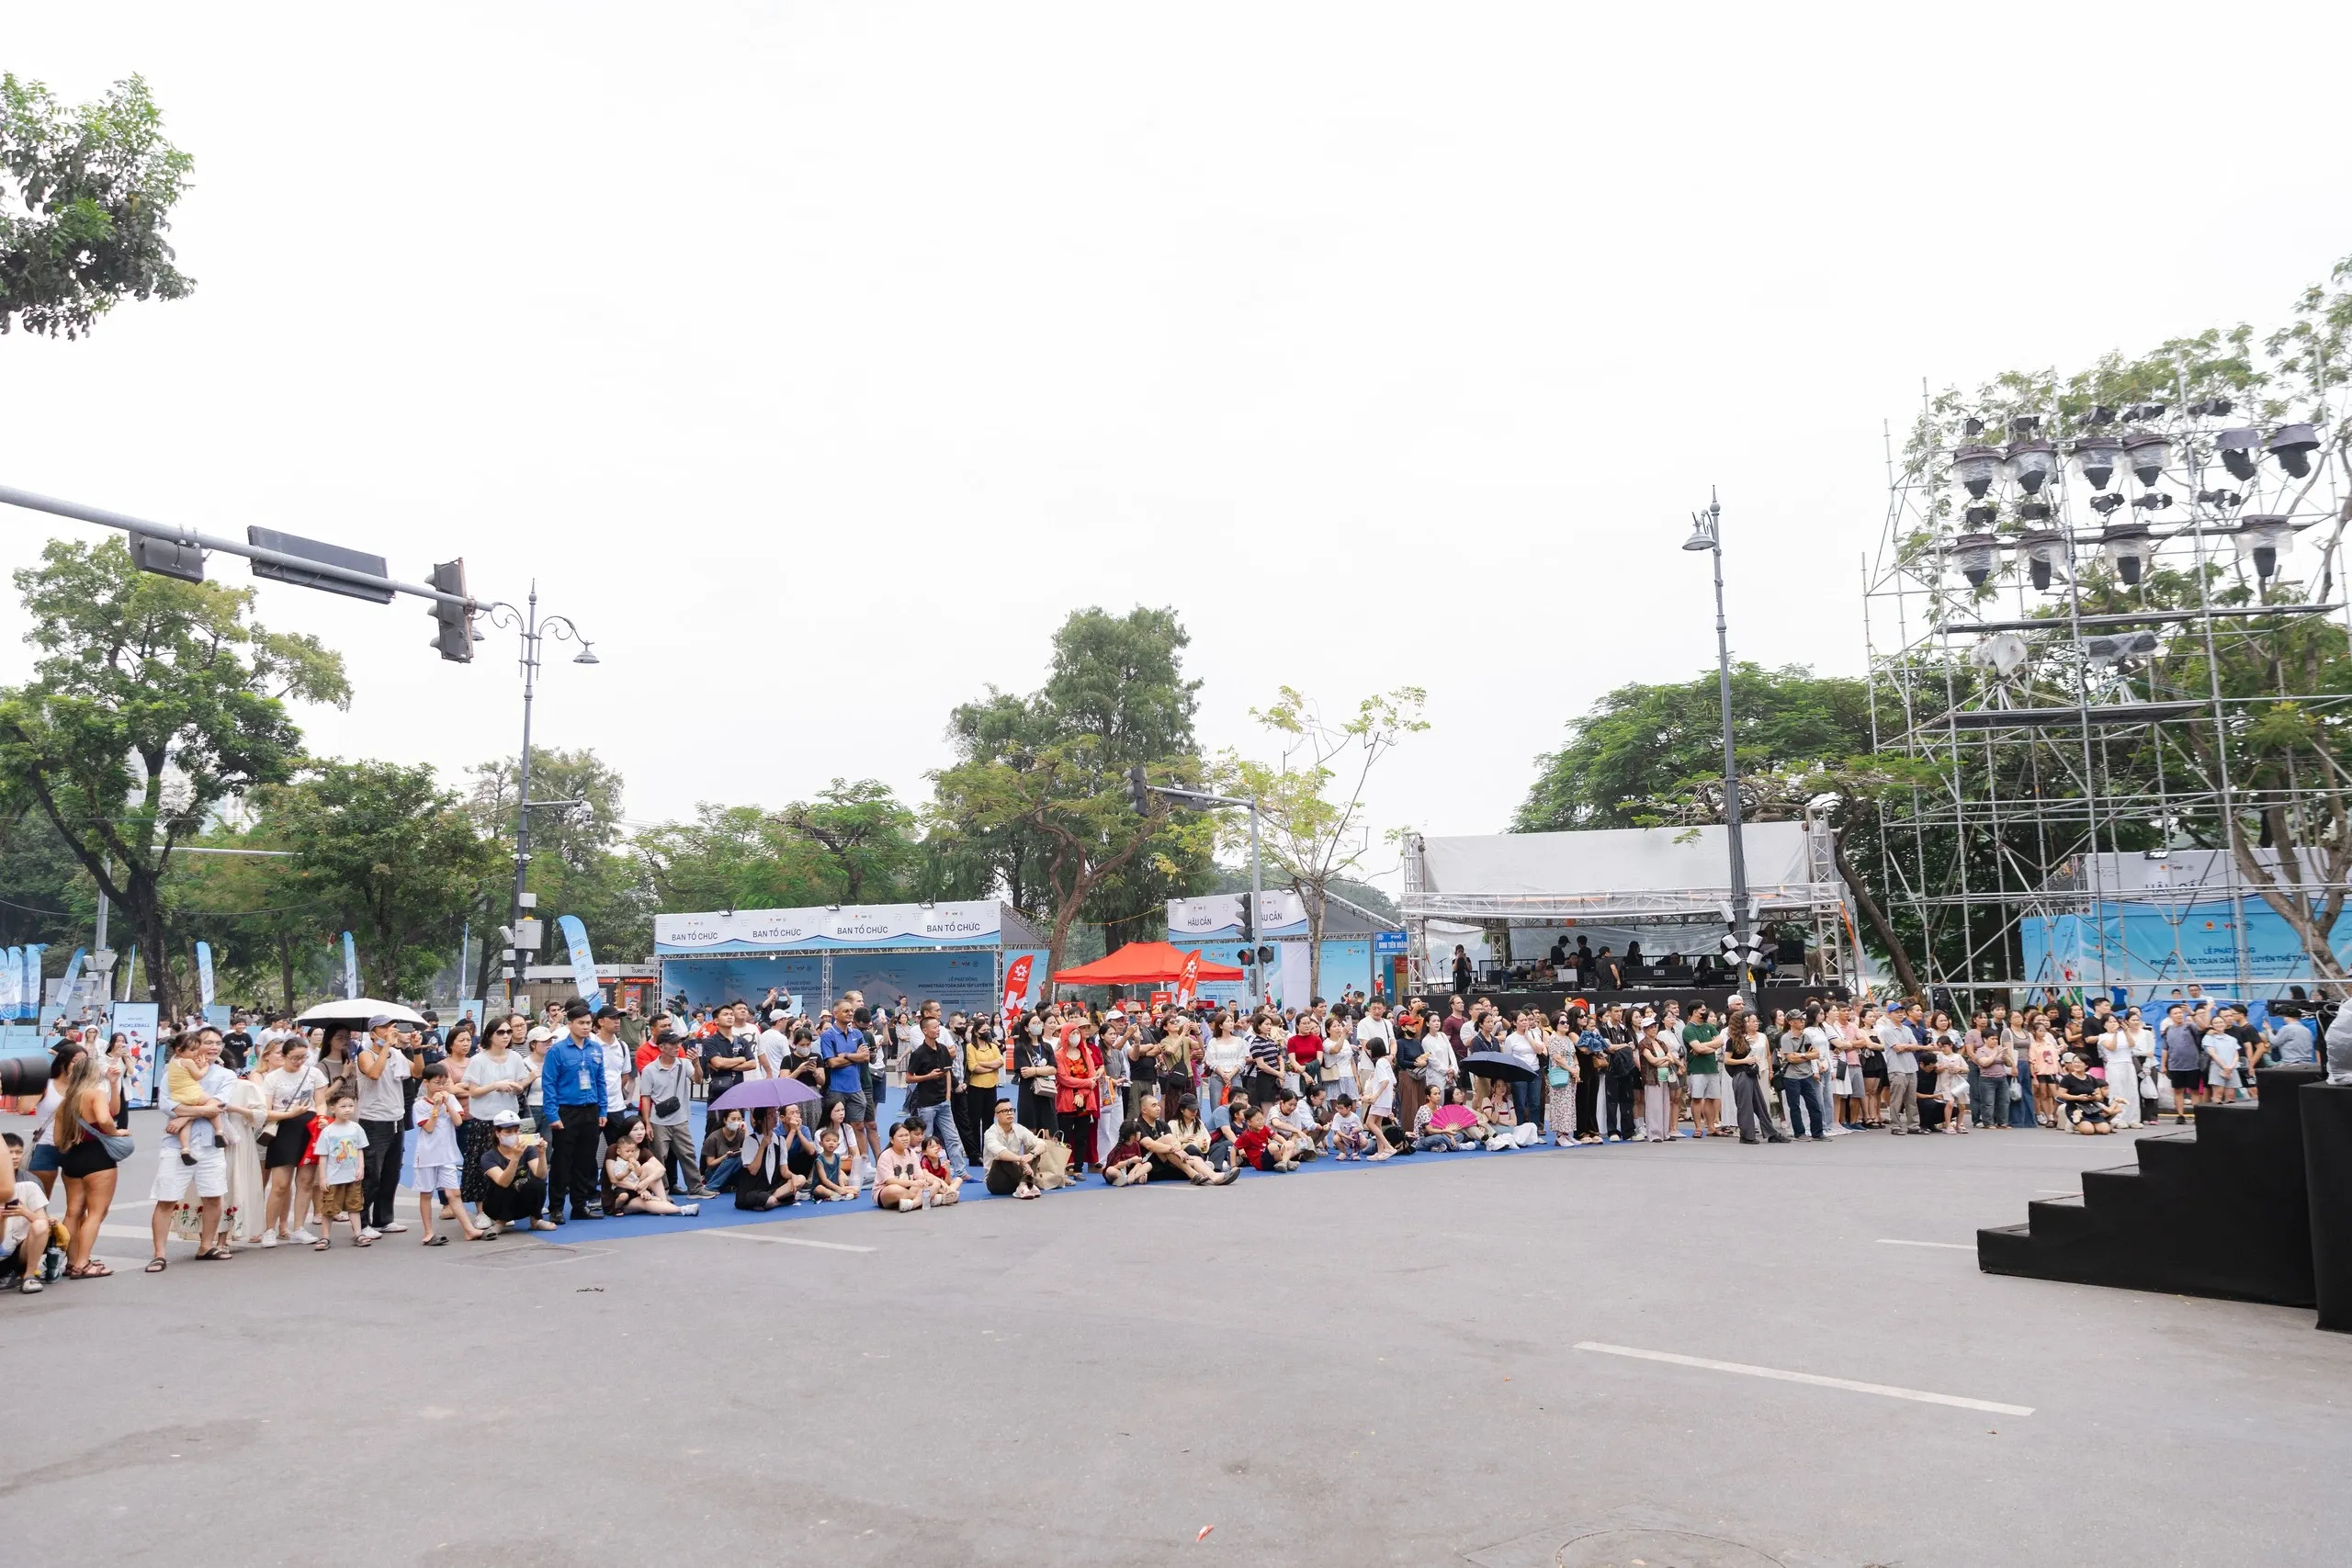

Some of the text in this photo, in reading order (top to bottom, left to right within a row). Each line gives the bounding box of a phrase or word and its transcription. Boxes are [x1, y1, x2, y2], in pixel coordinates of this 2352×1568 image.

[865, 925, 888, 933] CHỨC
[926, 924, 944, 932] BAN
[956, 922, 980, 931] CHỨC
[699, 931, 718, 940] CHỨC
[781, 928, 802, 936] CHỨC
